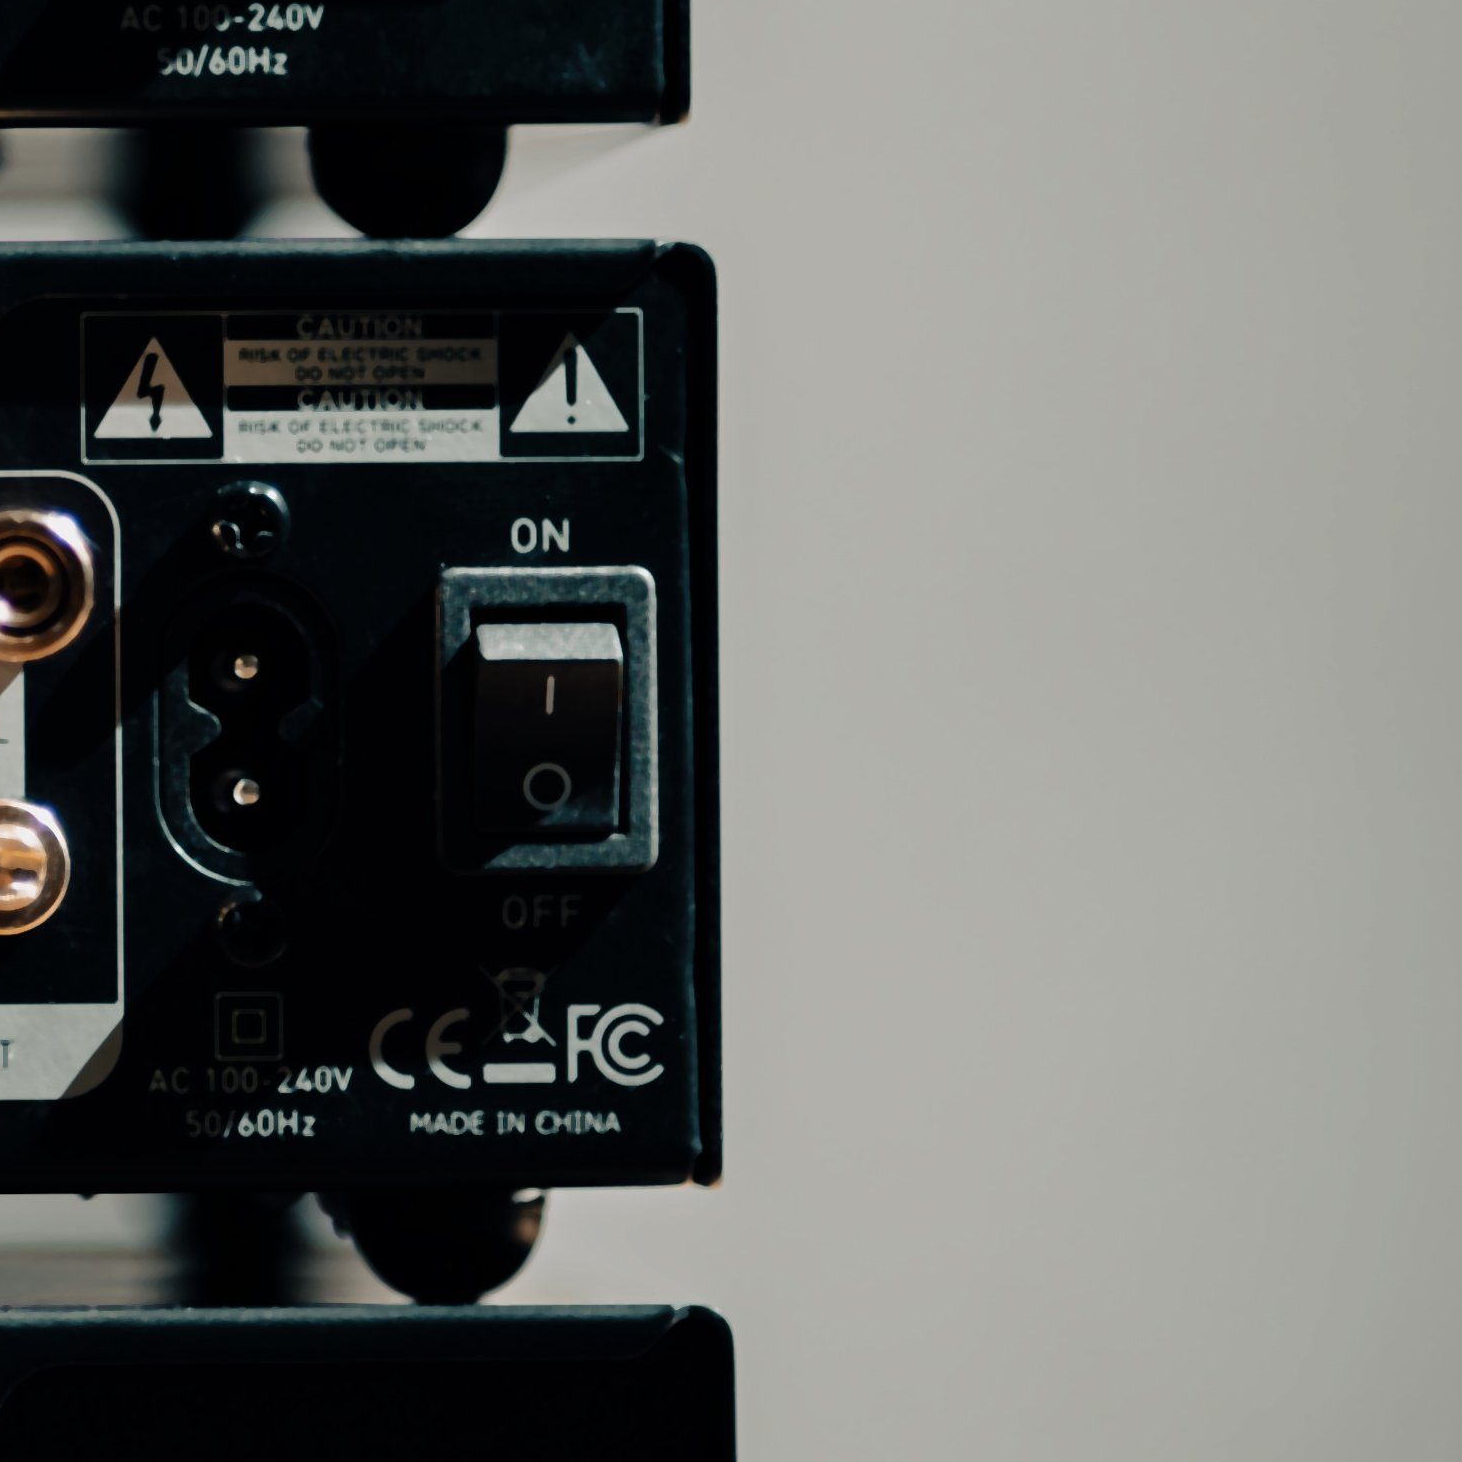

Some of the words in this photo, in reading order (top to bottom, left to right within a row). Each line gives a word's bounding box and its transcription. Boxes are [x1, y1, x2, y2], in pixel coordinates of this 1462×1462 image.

[120, 3, 164, 33] AC
[177, 2, 325, 33] 100-240V
[157, 43, 289, 78] 50/60Hz
[296, 316, 423, 339] CAUTION
[297, 388, 423, 411] CAUTION
[509, 518, 573, 555] ON
[500, 895, 583, 931] OFF
[369, 1006, 473, 1091] CE
[149, 1068, 189, 1095] AC
[206, 1065, 356, 1096] 100-240V
[186, 1107, 318, 1142] 50/60Hz
[409, 1111, 485, 1137] MADE
[497, 1111, 525, 1135] IN
[535, 1110, 623, 1135] CHINA
